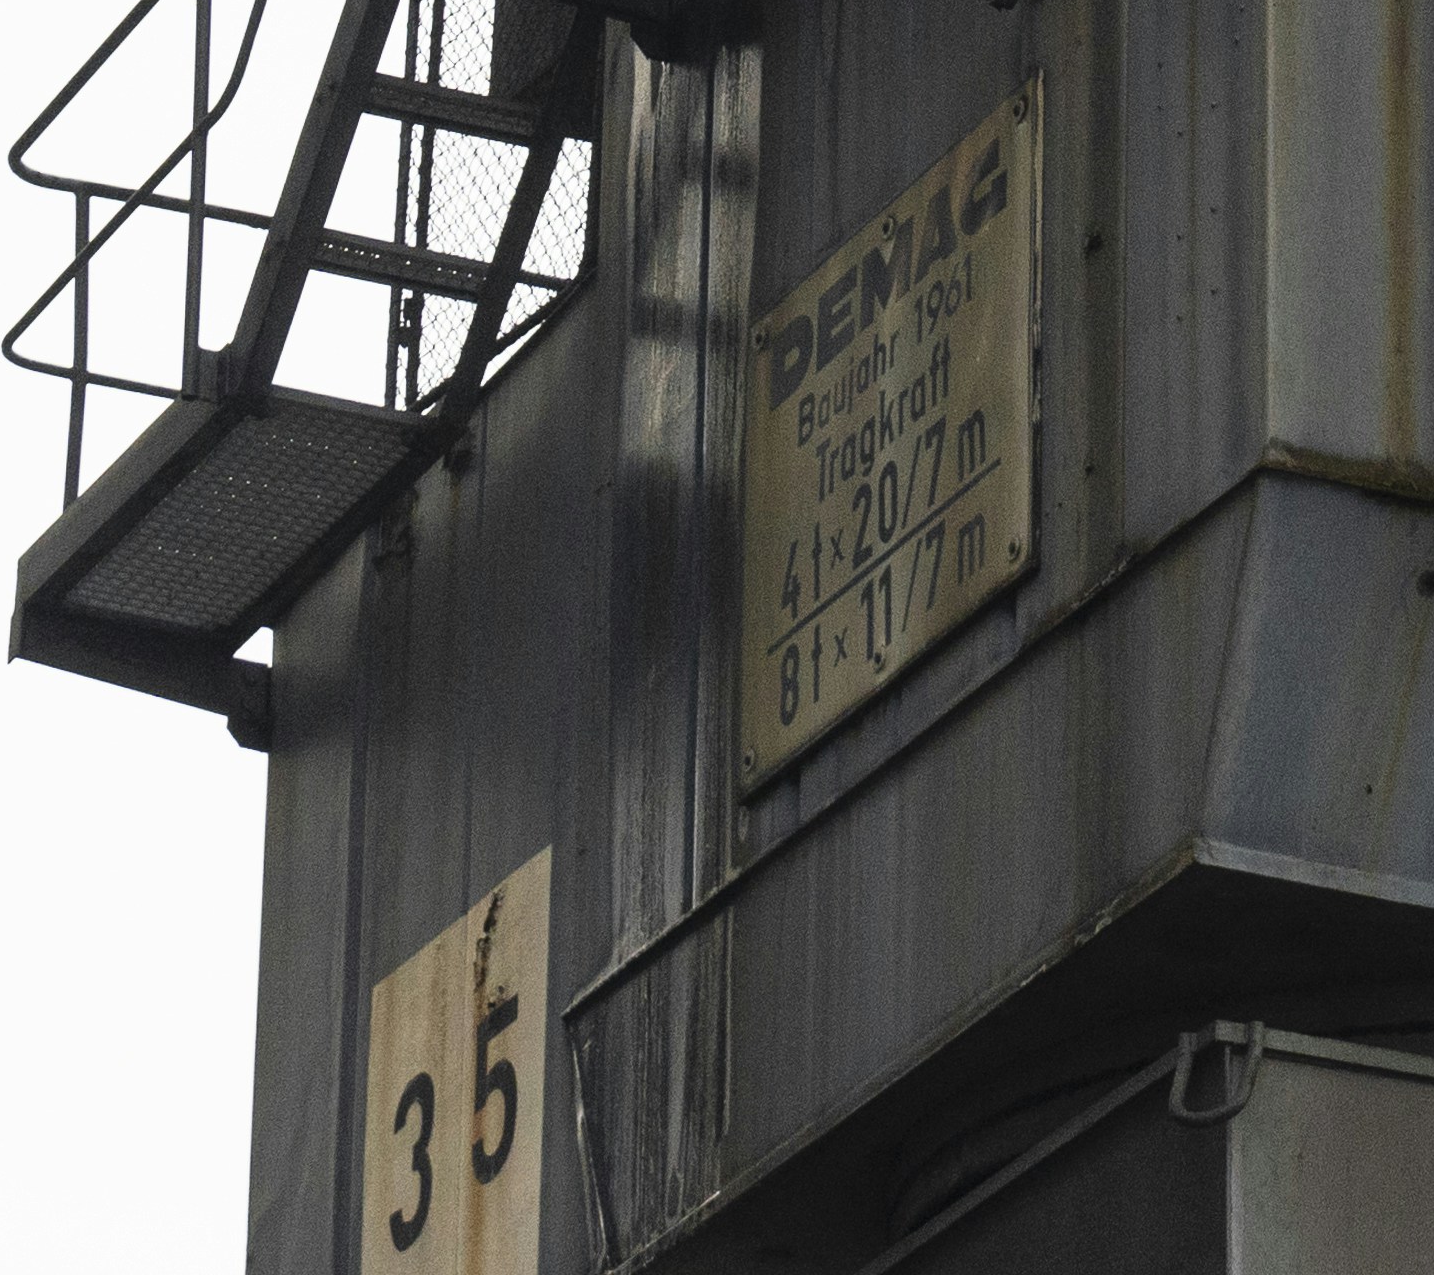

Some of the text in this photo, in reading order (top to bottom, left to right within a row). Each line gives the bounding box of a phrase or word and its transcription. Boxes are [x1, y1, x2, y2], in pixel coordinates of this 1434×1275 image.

[769, 136, 1007, 412] DEMAG
[798, 250, 972, 448] Baujahr 1961
[816, 334, 950, 503] Tragkraft
[958, 409, 985, 482] m
[958, 512, 985, 585] m
